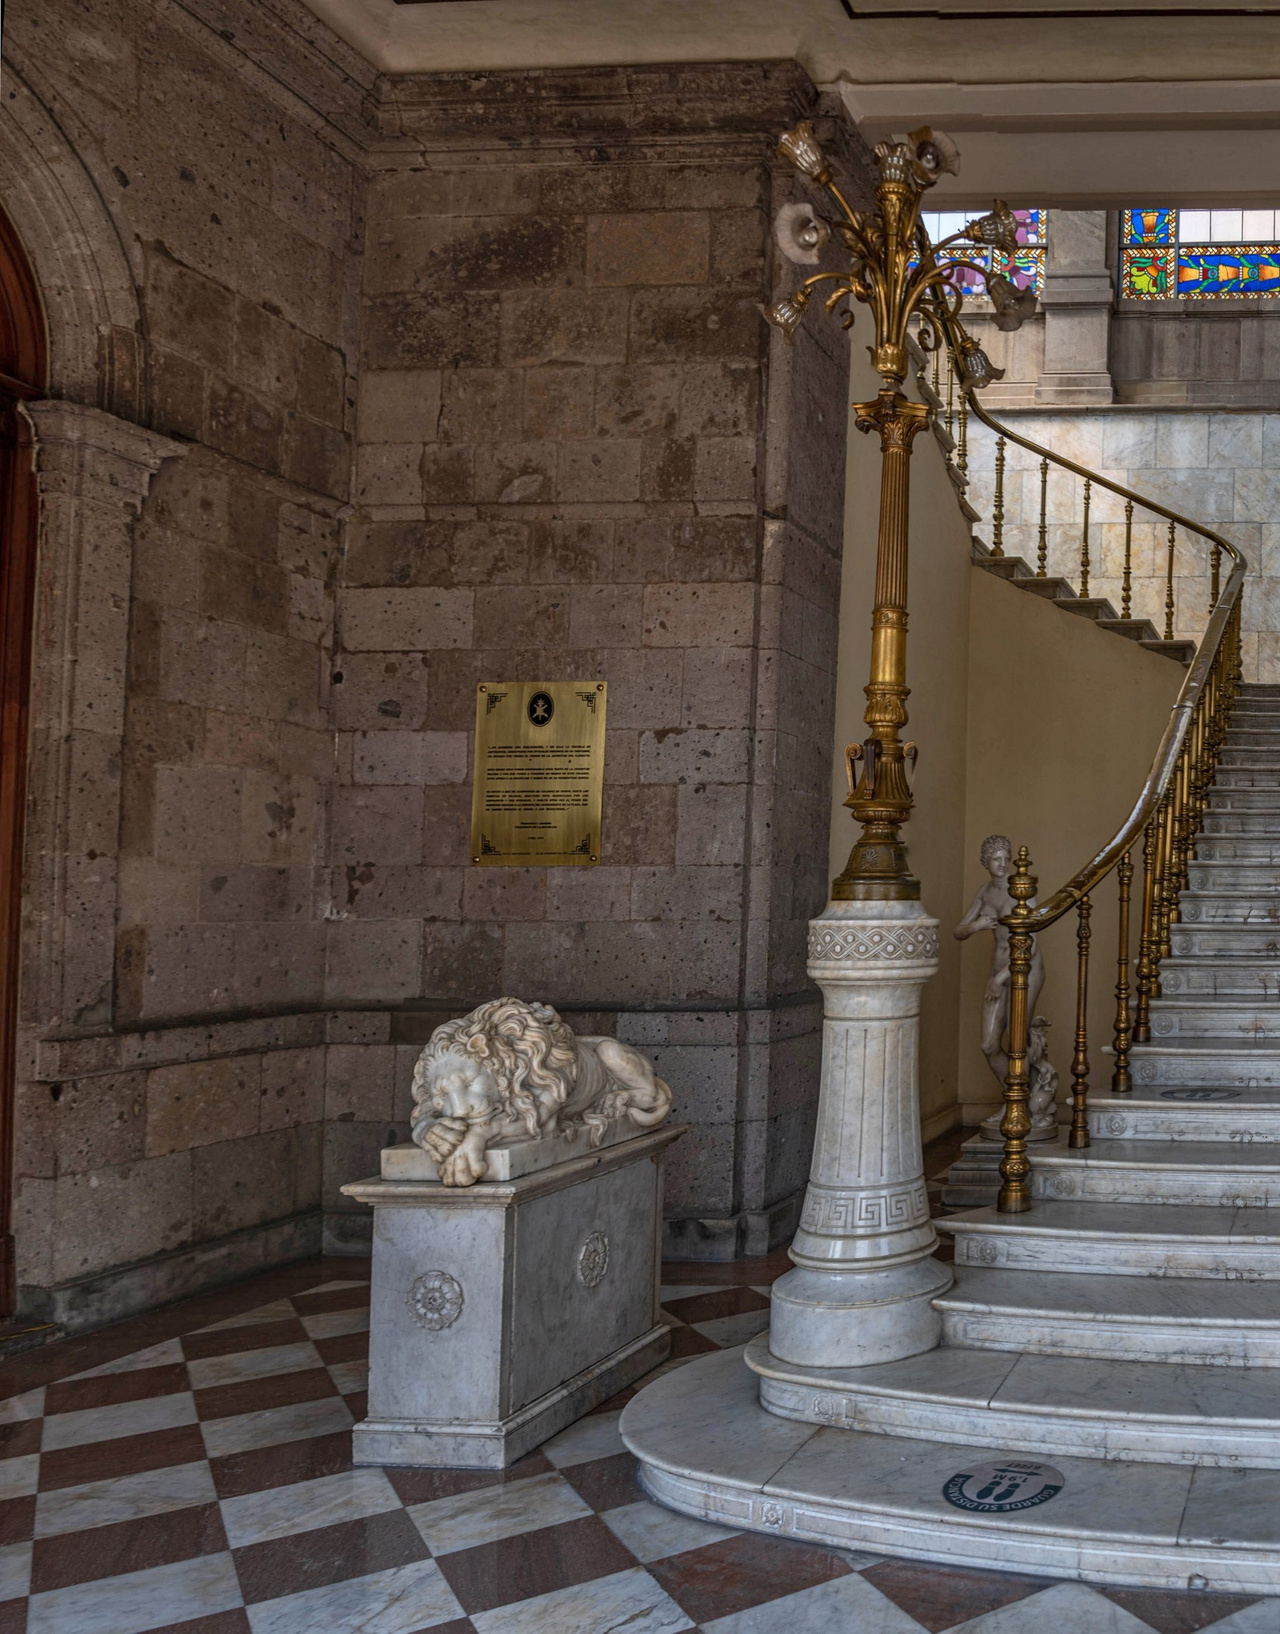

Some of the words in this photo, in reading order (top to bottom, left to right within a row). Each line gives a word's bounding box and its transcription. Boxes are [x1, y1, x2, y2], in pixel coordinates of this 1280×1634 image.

[1005, 1462, 1031, 1470] FEET
[992, 1473, 1007, 1481] M
[1008, 1474, 1028, 1483] 1.9
[948, 1477, 978, 1509] DISTANCIA
[1003, 1489, 1054, 1510] GUARDE
[979, 1503, 998, 1511] SU
